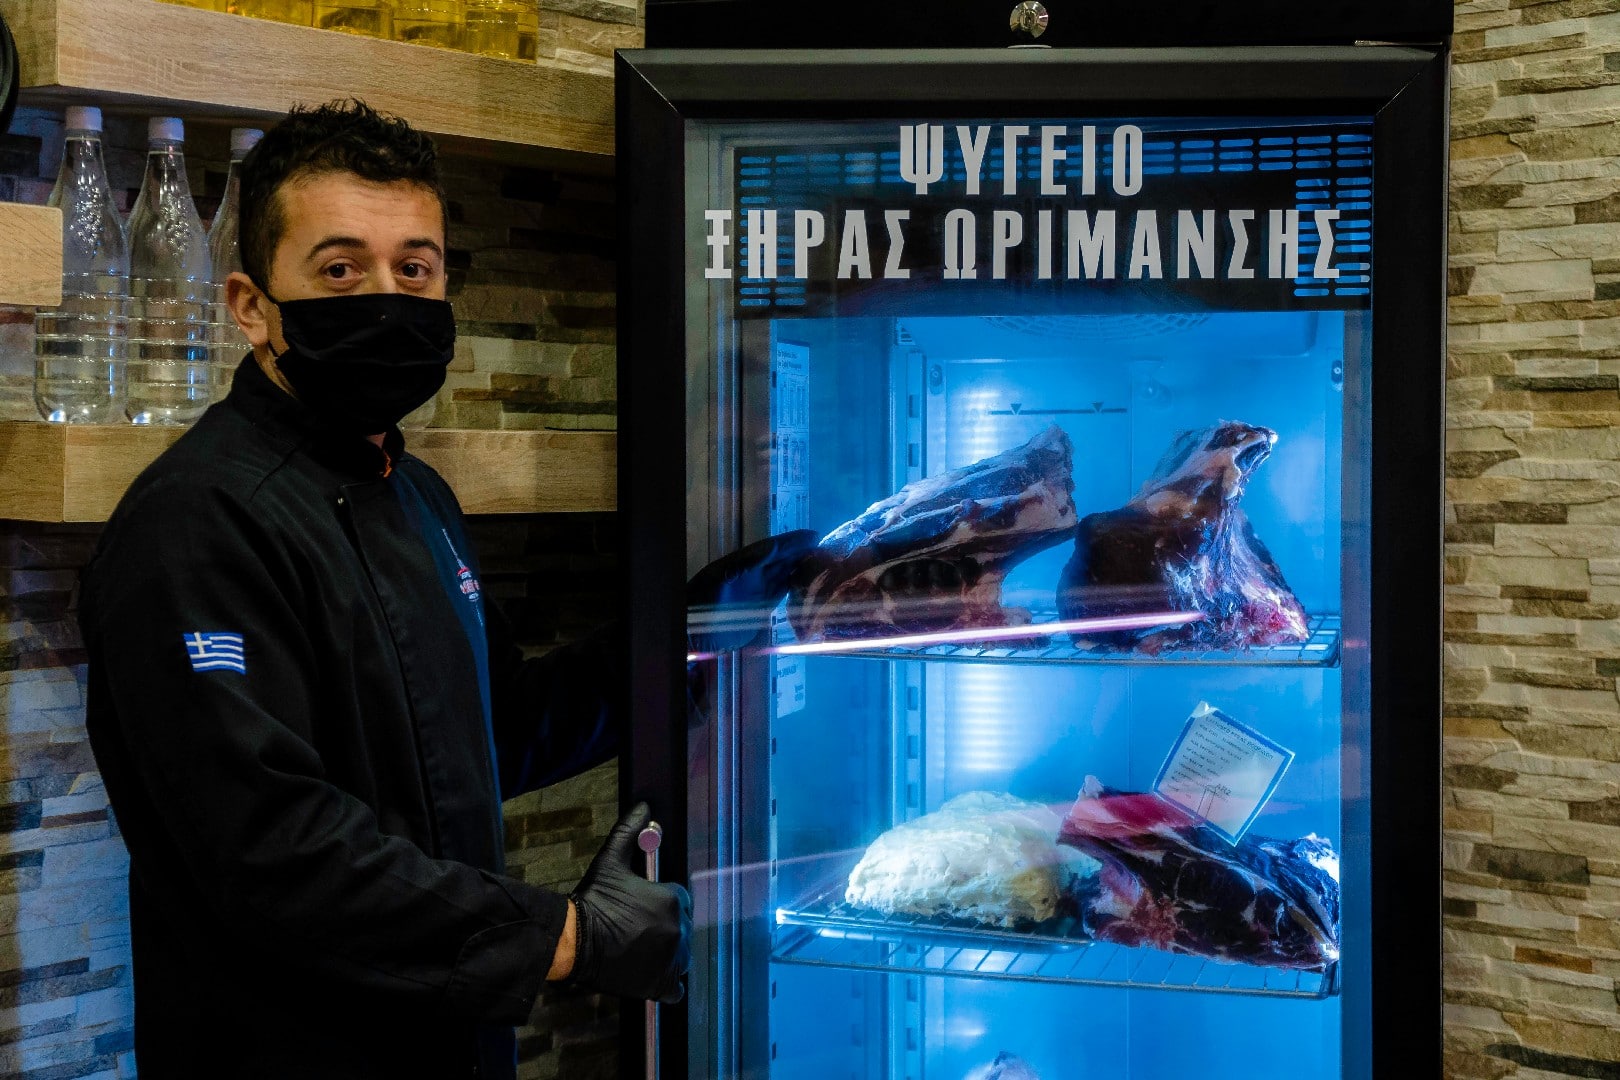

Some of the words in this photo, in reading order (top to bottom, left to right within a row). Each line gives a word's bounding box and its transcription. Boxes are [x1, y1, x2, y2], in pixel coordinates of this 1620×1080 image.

[900, 123, 1143, 196] ΨΥΓΕΙΟ
[704, 209, 910, 279] ΞΗΡΑΣ
[943, 209, 1340, 279] ΩΡΙΜΑΝΣΗΣ
